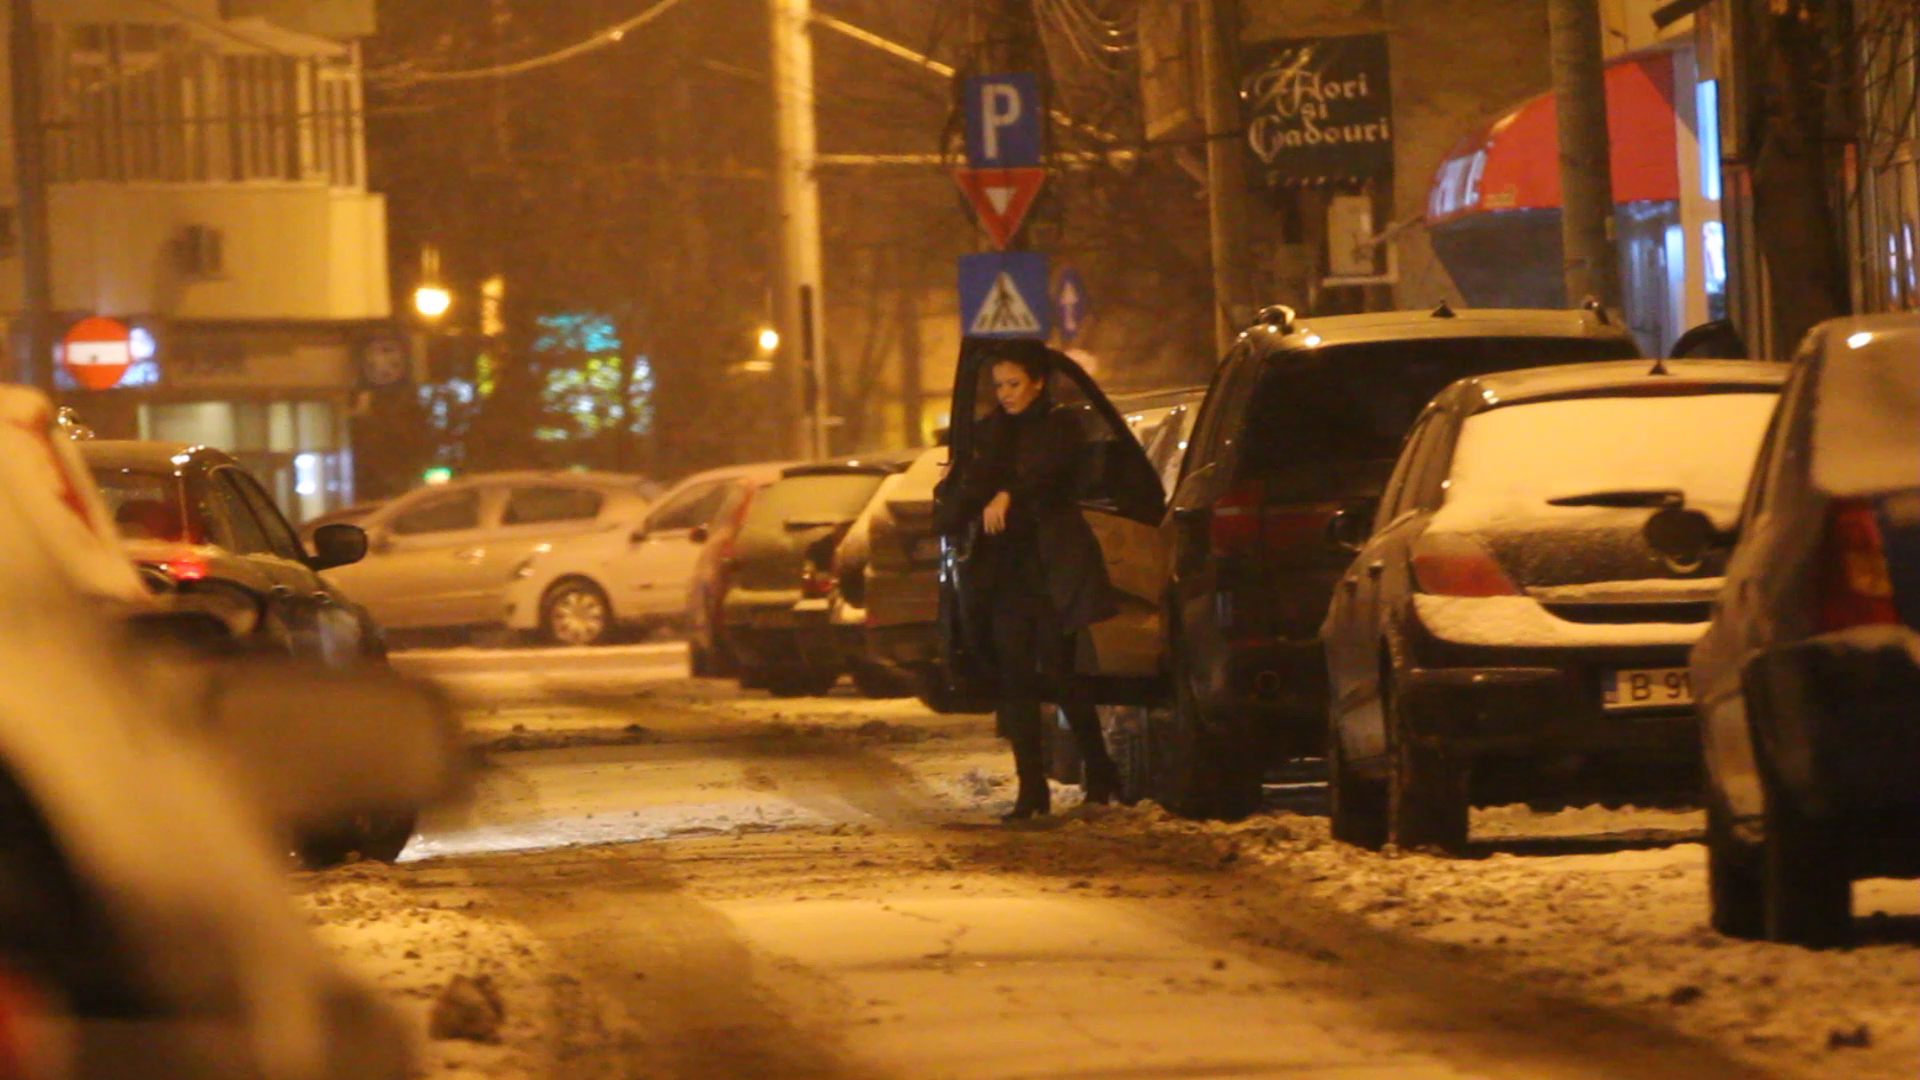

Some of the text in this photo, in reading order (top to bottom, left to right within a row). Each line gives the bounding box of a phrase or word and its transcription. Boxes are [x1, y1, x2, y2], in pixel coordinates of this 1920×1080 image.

[981, 83, 1021, 159] P
[1249, 116, 1390, 163] Cadouri
[1631, 673, 1650, 701] B
